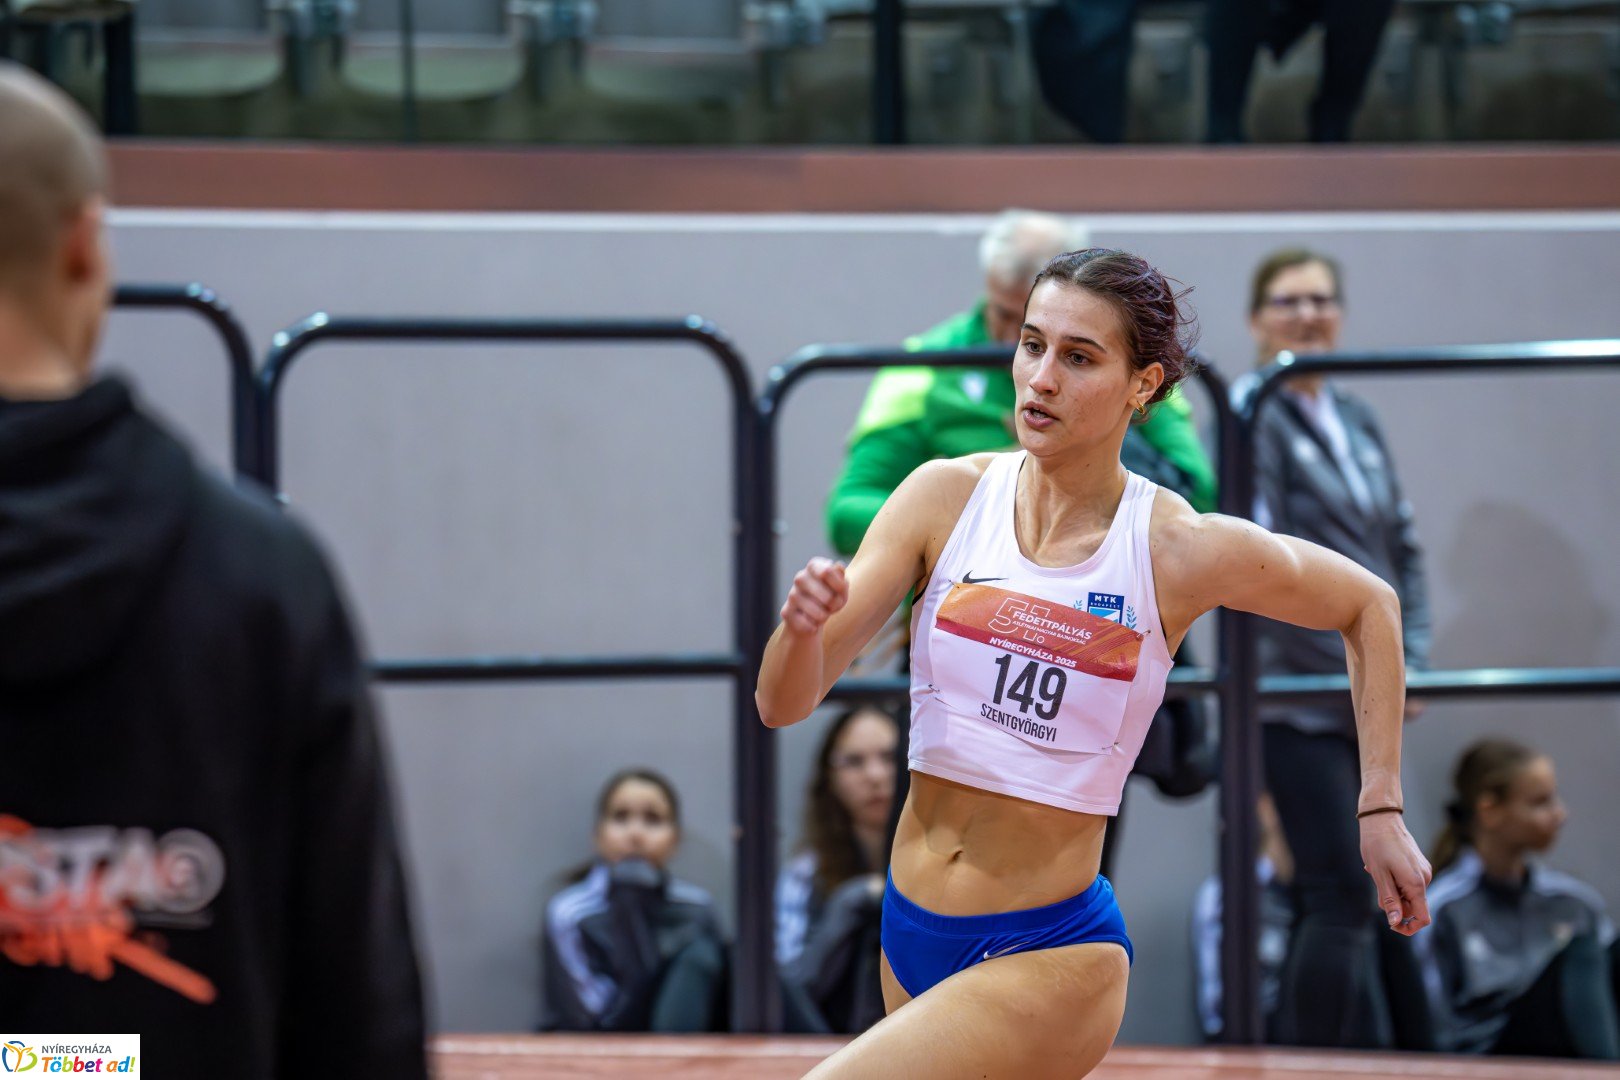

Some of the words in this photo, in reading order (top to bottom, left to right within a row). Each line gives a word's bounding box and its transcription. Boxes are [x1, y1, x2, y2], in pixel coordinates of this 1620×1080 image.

[1094, 595, 1117, 603] MTK
[1012, 611, 1092, 639] FEDETTPÁLYÁS
[989, 637, 1053, 661] NYÍREGYHÁZA
[1054, 655, 1078, 668] 2025
[993, 654, 1067, 720] 149
[981, 703, 1057, 741] SZENTGYÖRGYI
